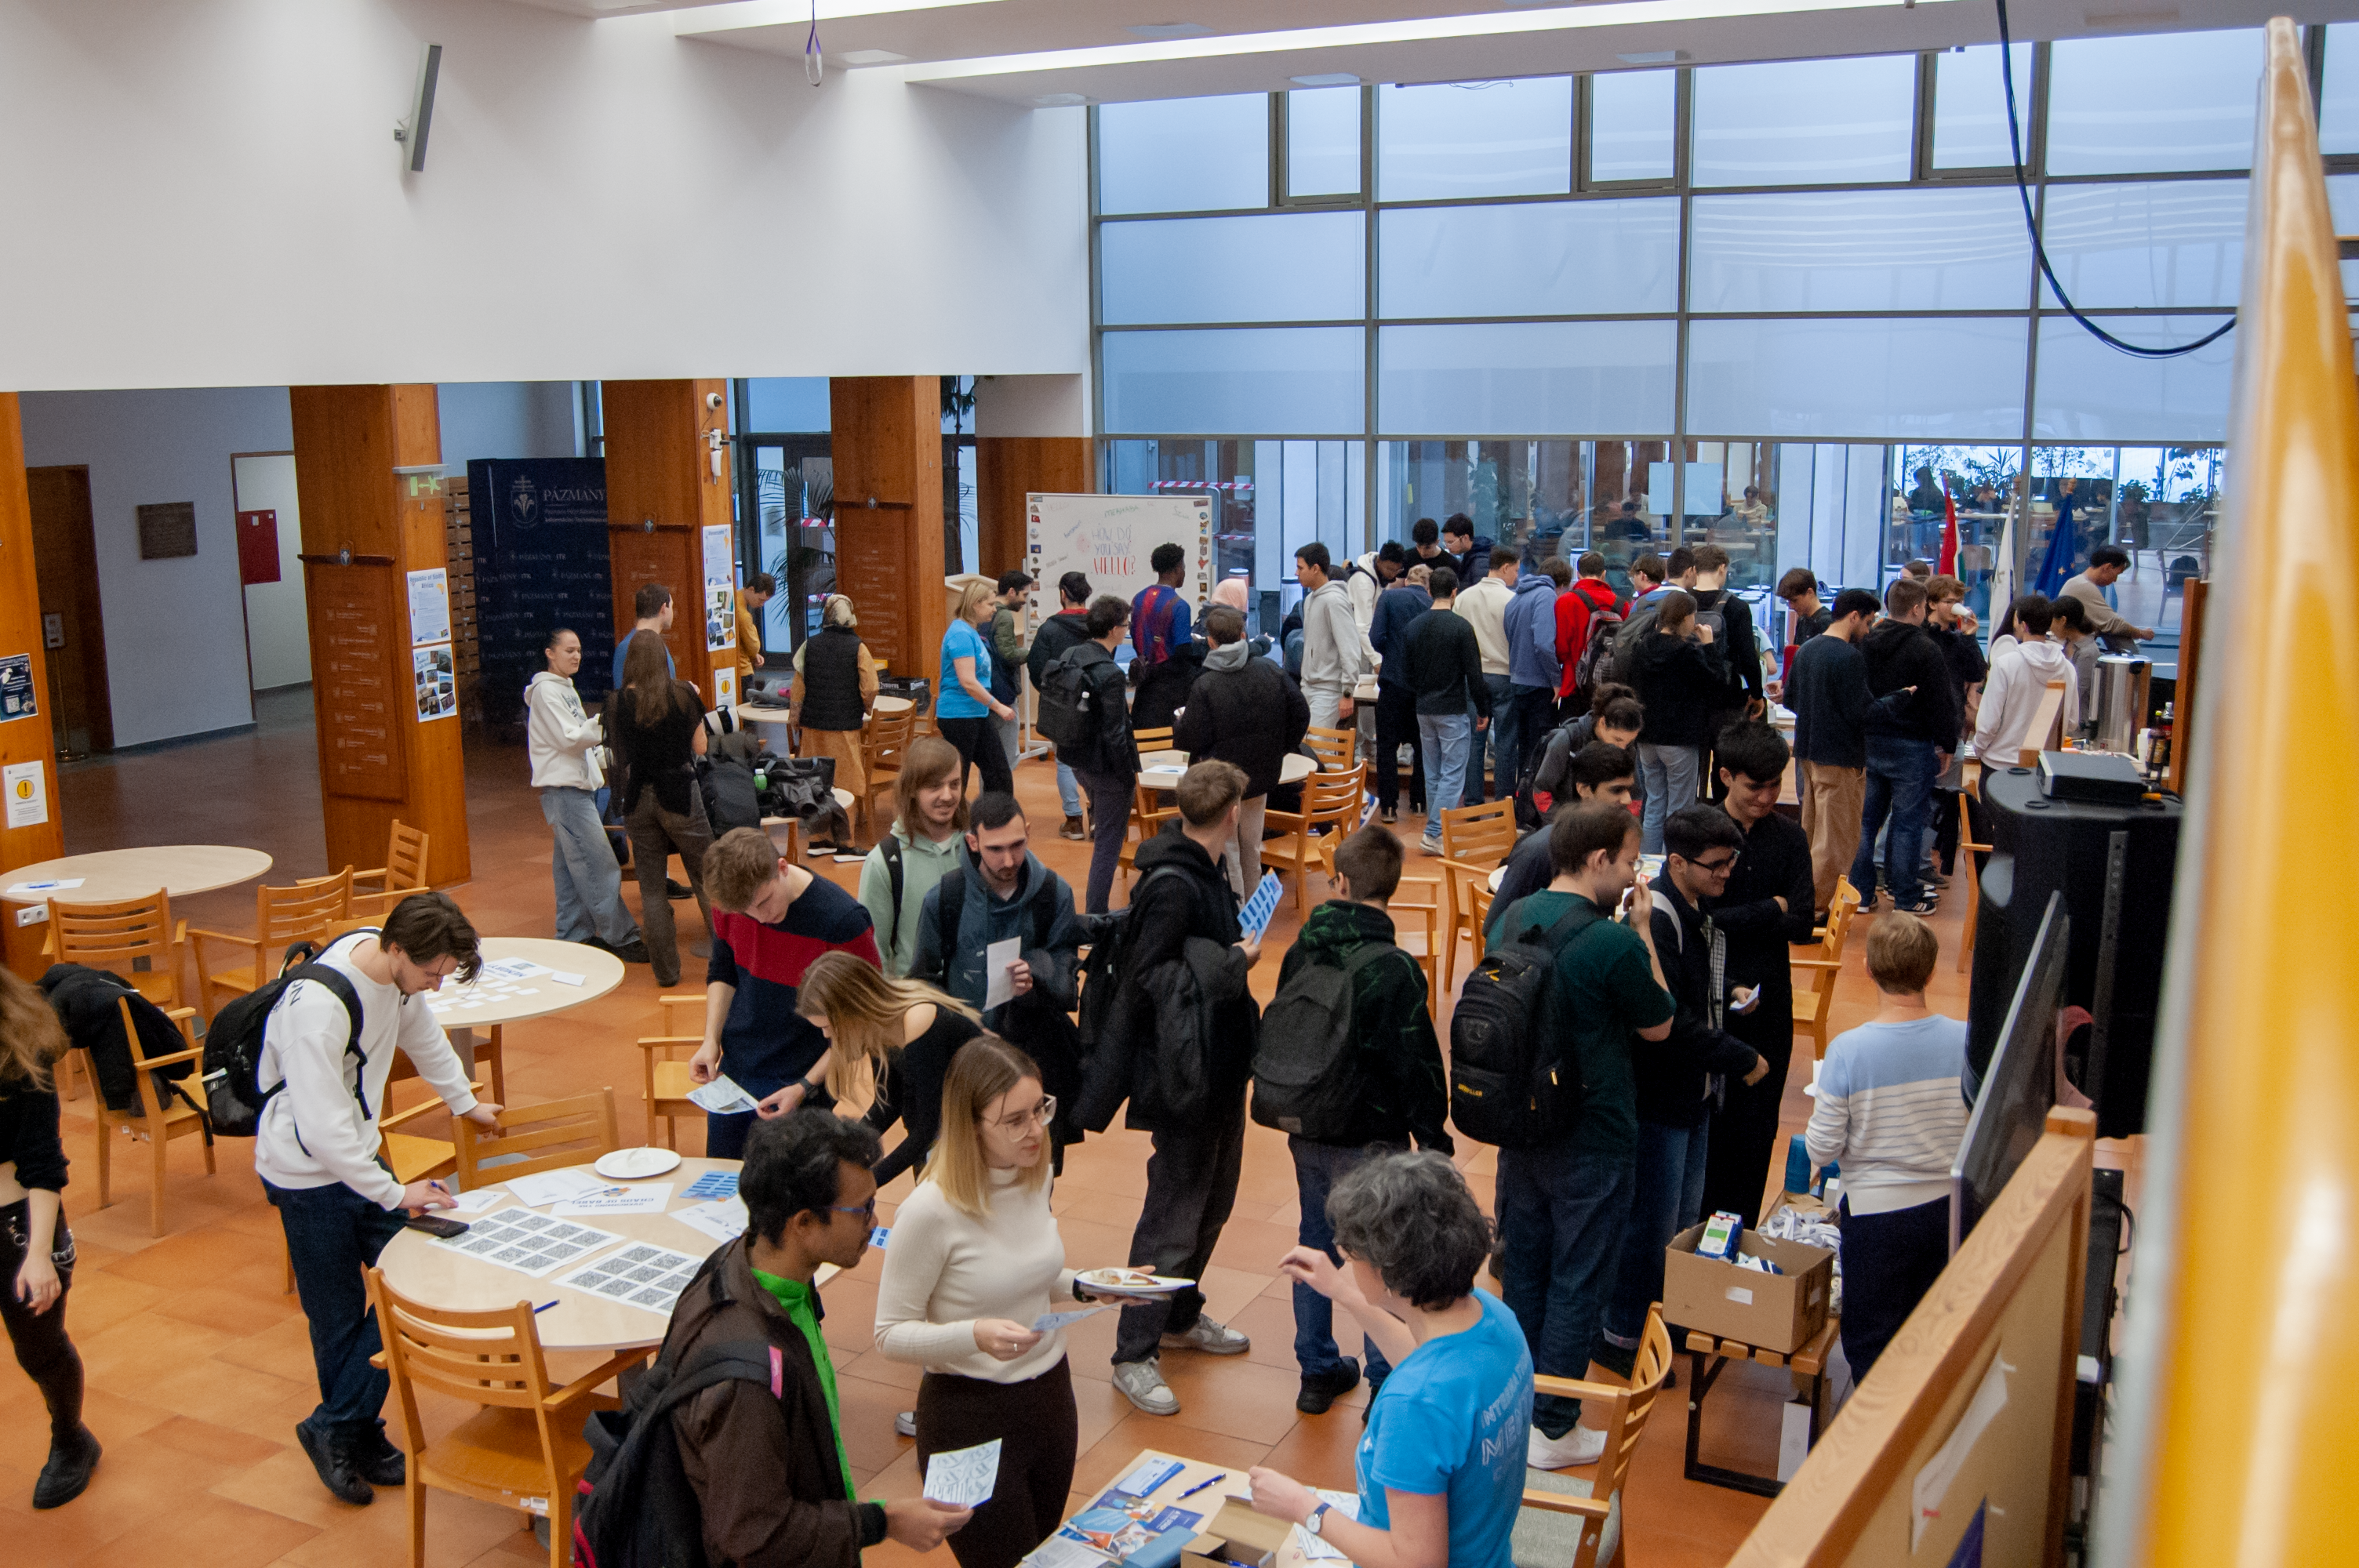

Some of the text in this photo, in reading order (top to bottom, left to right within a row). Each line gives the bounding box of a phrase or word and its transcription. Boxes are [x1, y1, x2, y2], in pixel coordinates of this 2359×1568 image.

[543, 487, 607, 502] PÁZMÁNY
[1092, 527, 1113, 541] HOW
[1117, 527, 1132, 541] DO
[1094, 543, 1130, 556] YOU SAY
[1093, 555, 1136, 576] HELLO?
